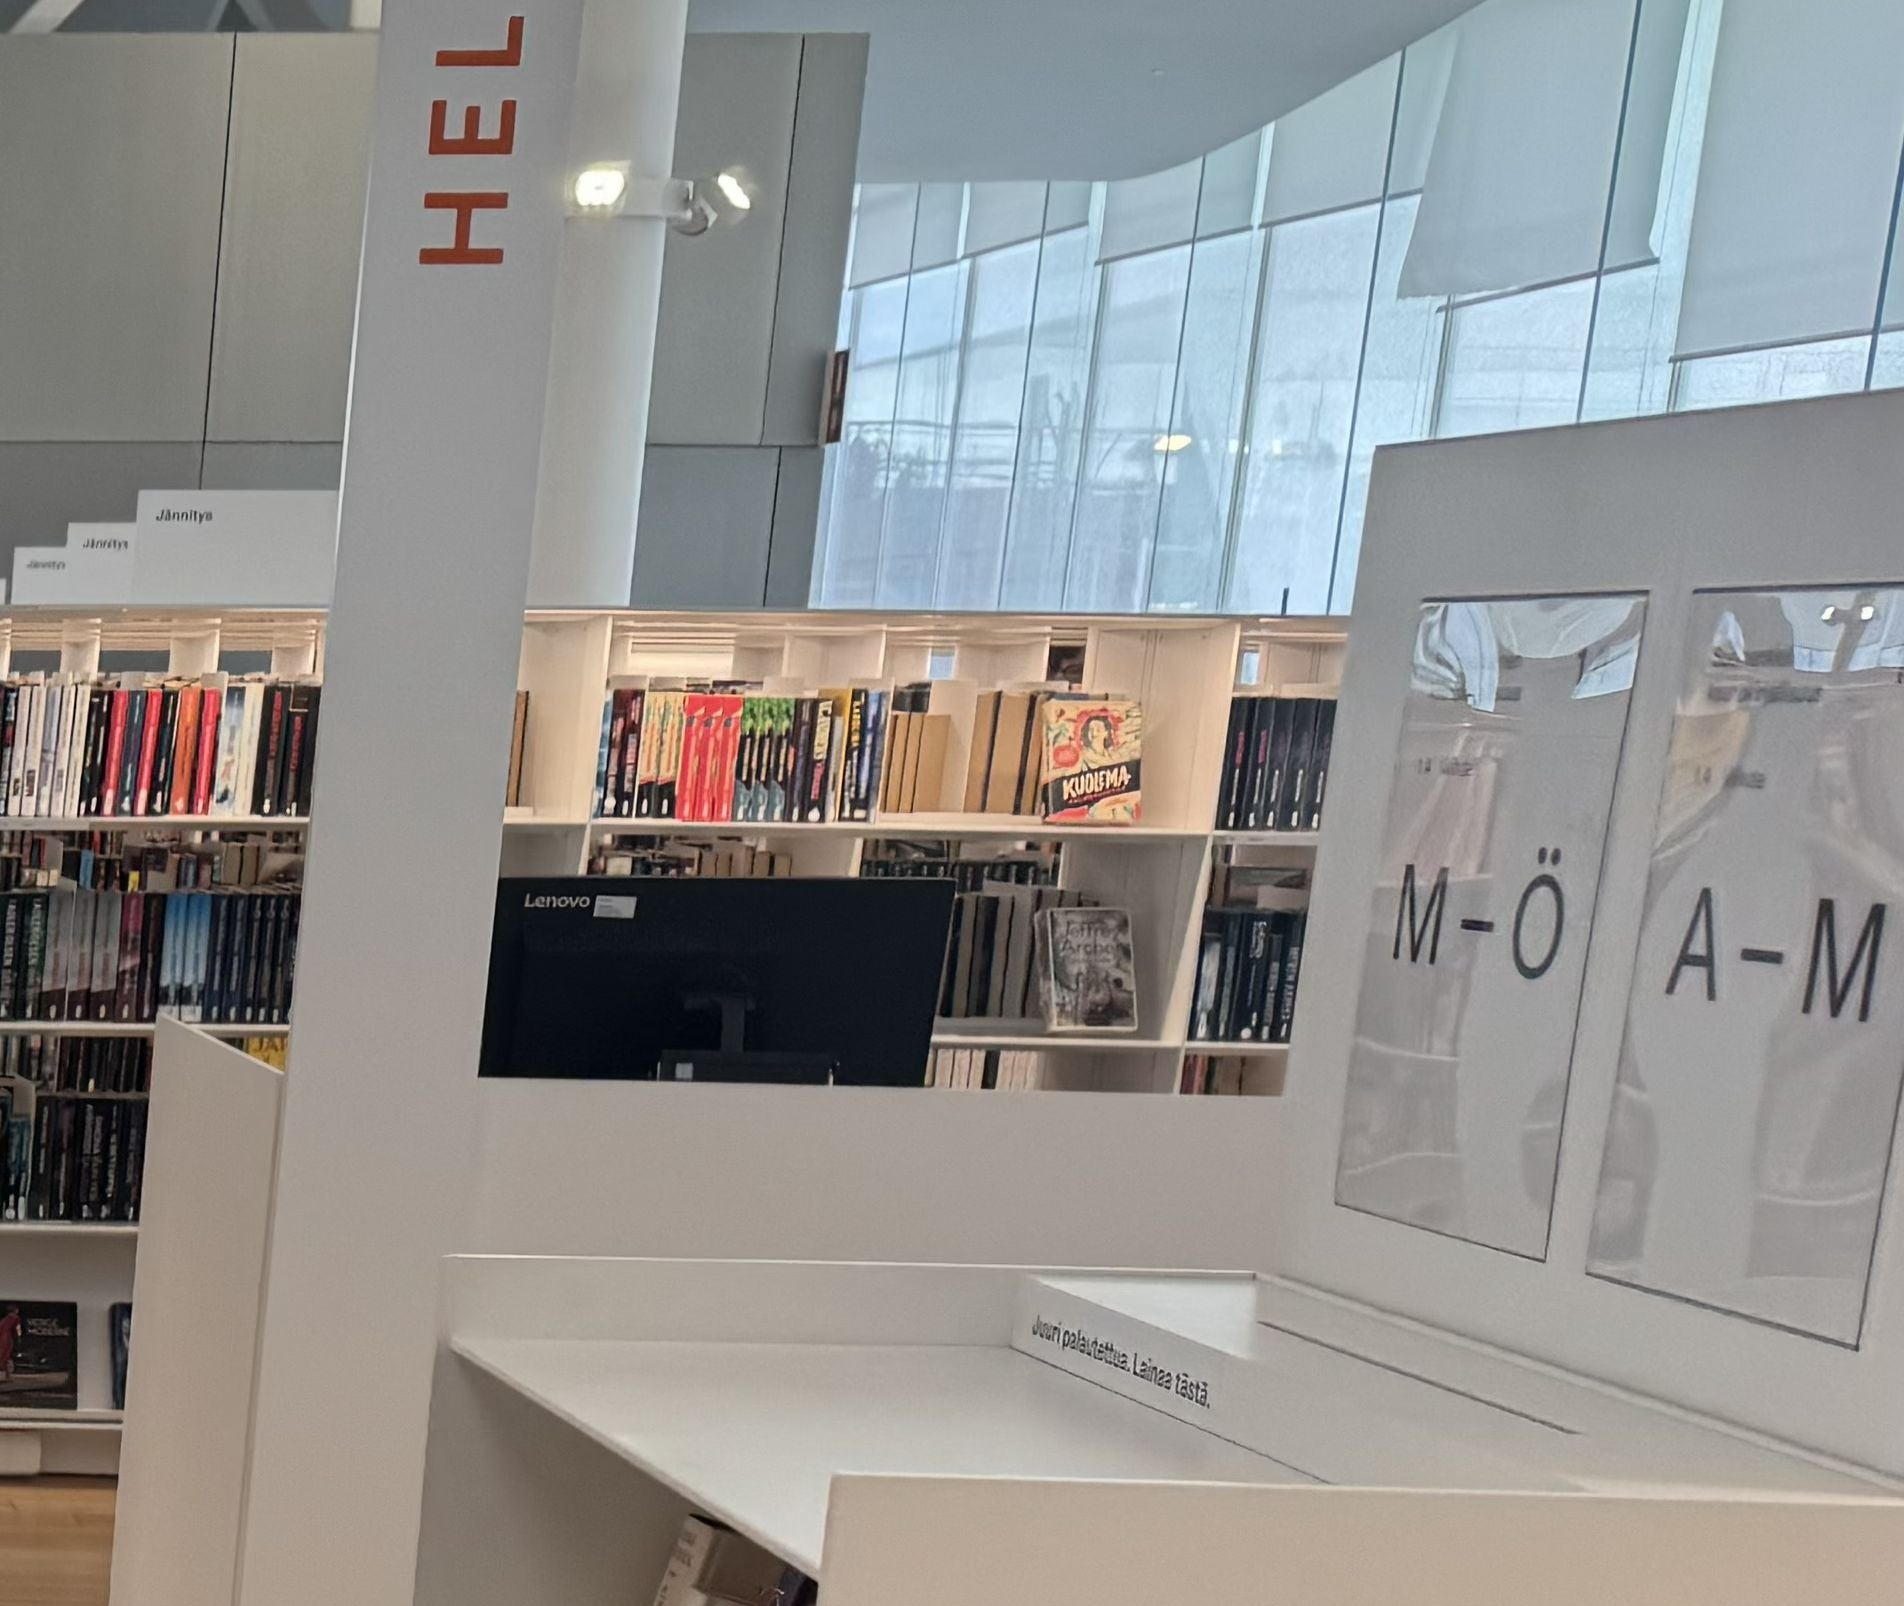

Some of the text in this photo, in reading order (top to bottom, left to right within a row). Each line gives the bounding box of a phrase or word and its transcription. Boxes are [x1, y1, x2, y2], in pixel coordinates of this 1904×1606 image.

[419, 16, 524, 264] HEL
[156, 508, 213, 524] Jännitys
[1063, 765, 1131, 800] KUOLEMA
[524, 893, 591, 908] Lenovo
[1392, 845, 1565, 981] M-Ö
[1665, 887, 1887, 1023] A-M
[1032, 1314, 1061, 1345] Juuri
[1133, 1353, 1173, 1391] Lainaa
